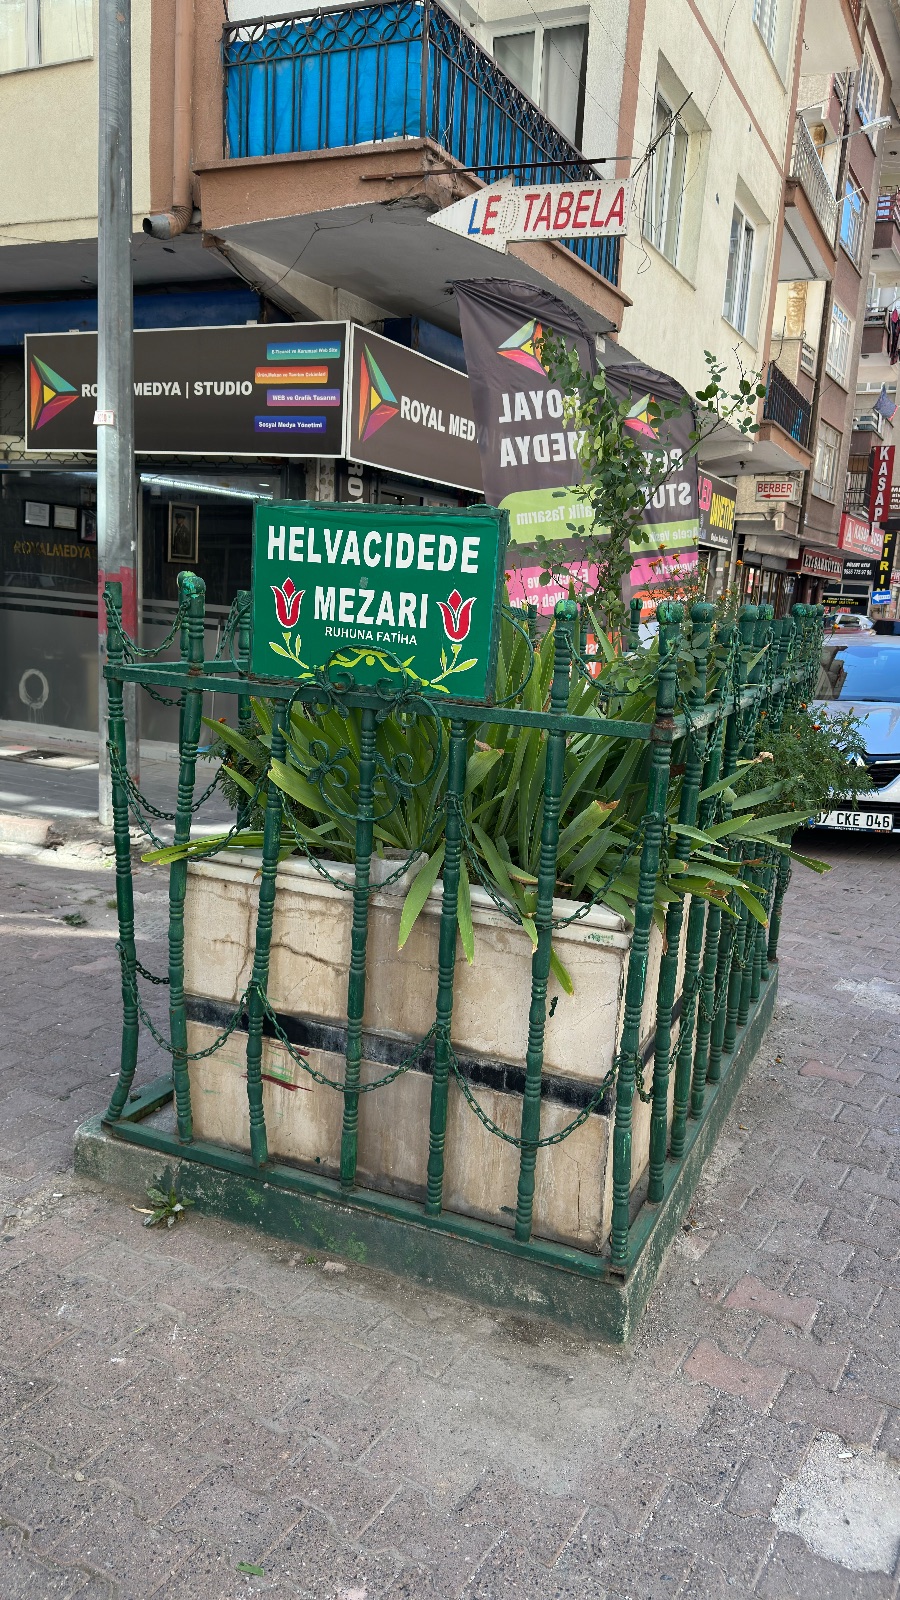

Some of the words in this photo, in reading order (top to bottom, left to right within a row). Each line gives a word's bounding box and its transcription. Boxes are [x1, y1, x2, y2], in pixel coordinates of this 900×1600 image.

[523, 186, 625, 232] TABELA
[193, 380, 253, 396] STUDIO
[258, 421, 277, 429] Sosyal
[277, 421, 296, 429] Medya
[297, 421, 323, 429] Yönetimi
[400, 395, 446, 432] ROYAL
[448, 413, 479, 444] MED
[757, 483, 792, 493] BERBER
[874, 446, 889, 521] KASAP
[266, 525, 481, 574] HELVACIDEDE
[875, 533, 893, 591] FIRI
[313, 585, 429, 629] MEZARI
[324, 626, 374, 642] RUHUNA
[375, 630, 418, 646] FATİHA
[836, 812, 861, 826] CKE
[866, 814, 890, 828] 046
